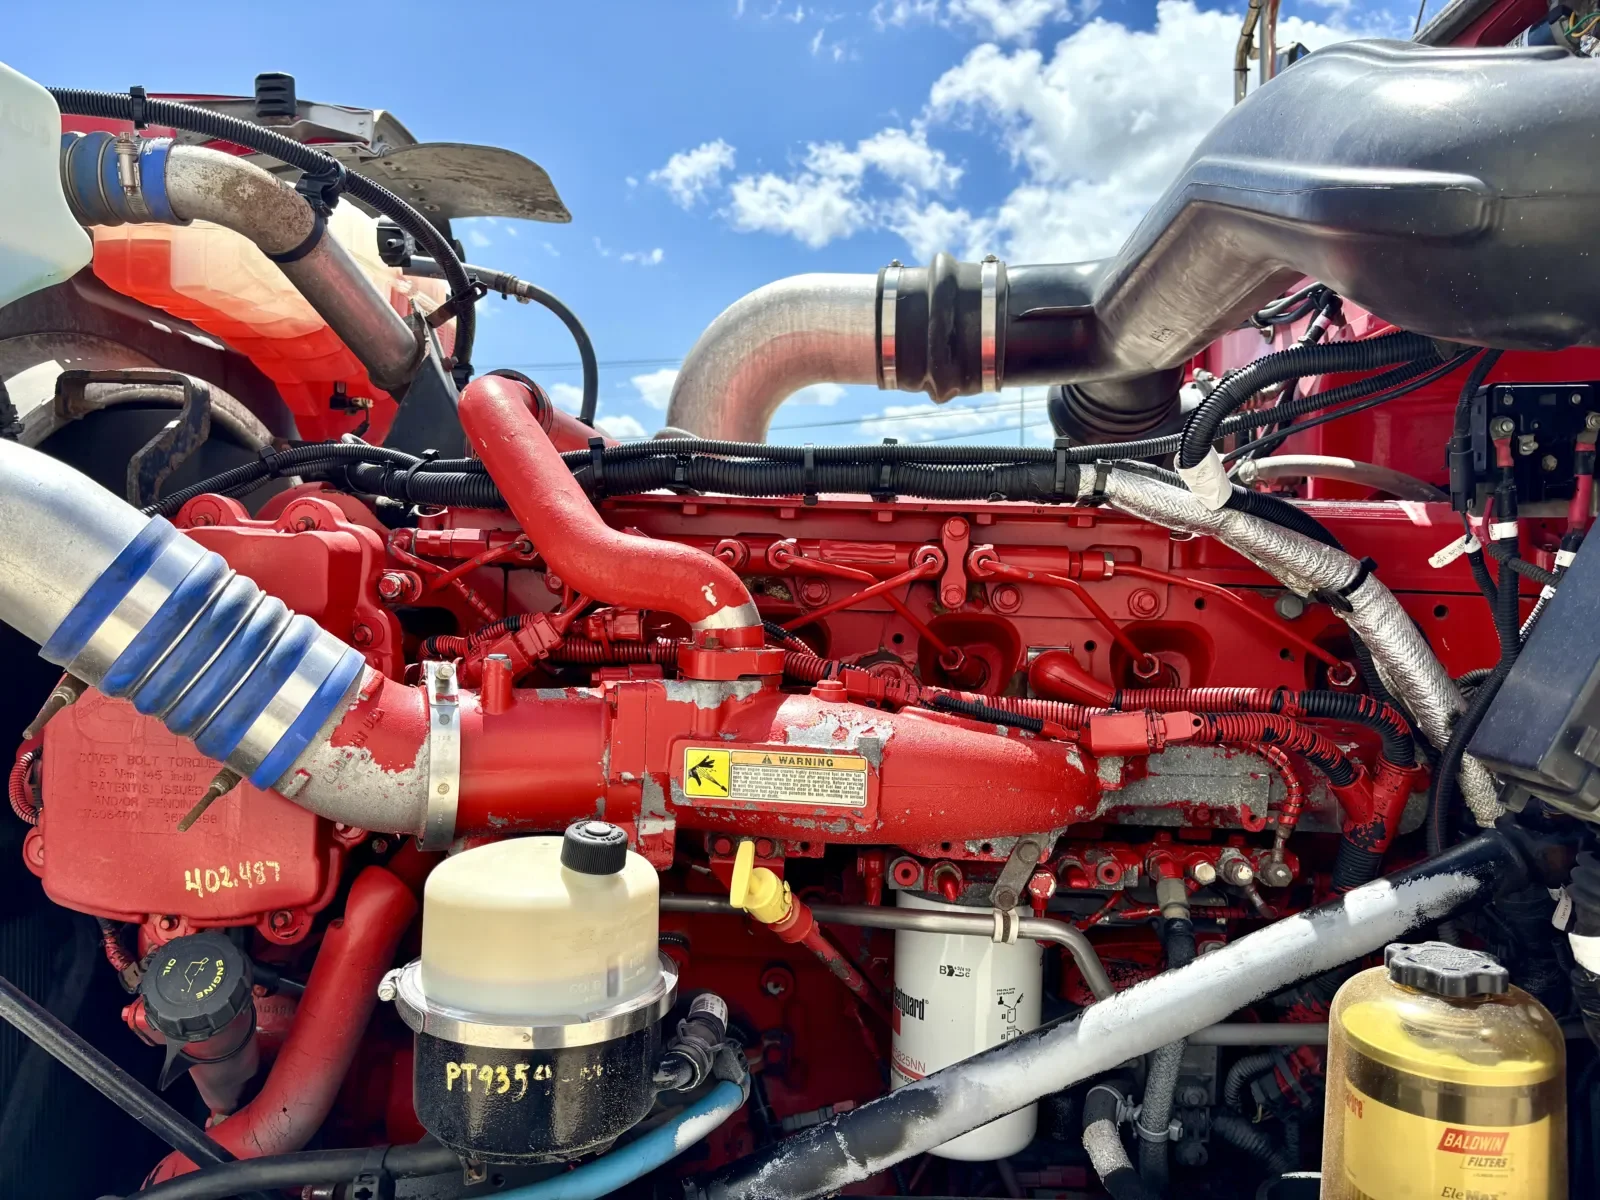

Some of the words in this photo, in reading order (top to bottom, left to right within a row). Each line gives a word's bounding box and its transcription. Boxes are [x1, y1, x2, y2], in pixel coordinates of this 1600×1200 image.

[80, 752, 118, 764] COVER
[128, 755, 159, 766] BOLT
[168, 756, 216, 768] TORQUE
[778, 756, 834, 768] WARNING
[161, 784, 204, 796] ISSUED
[184, 860, 280, 898] 402.487
[162, 958, 176, 976] OIL
[940, 965, 946, 974] B
[196, 960, 224, 1000] ENGINE
[1444, 1132, 1504, 1152] BALDWIN
[1468, 1156, 1508, 1168] FILTERS
